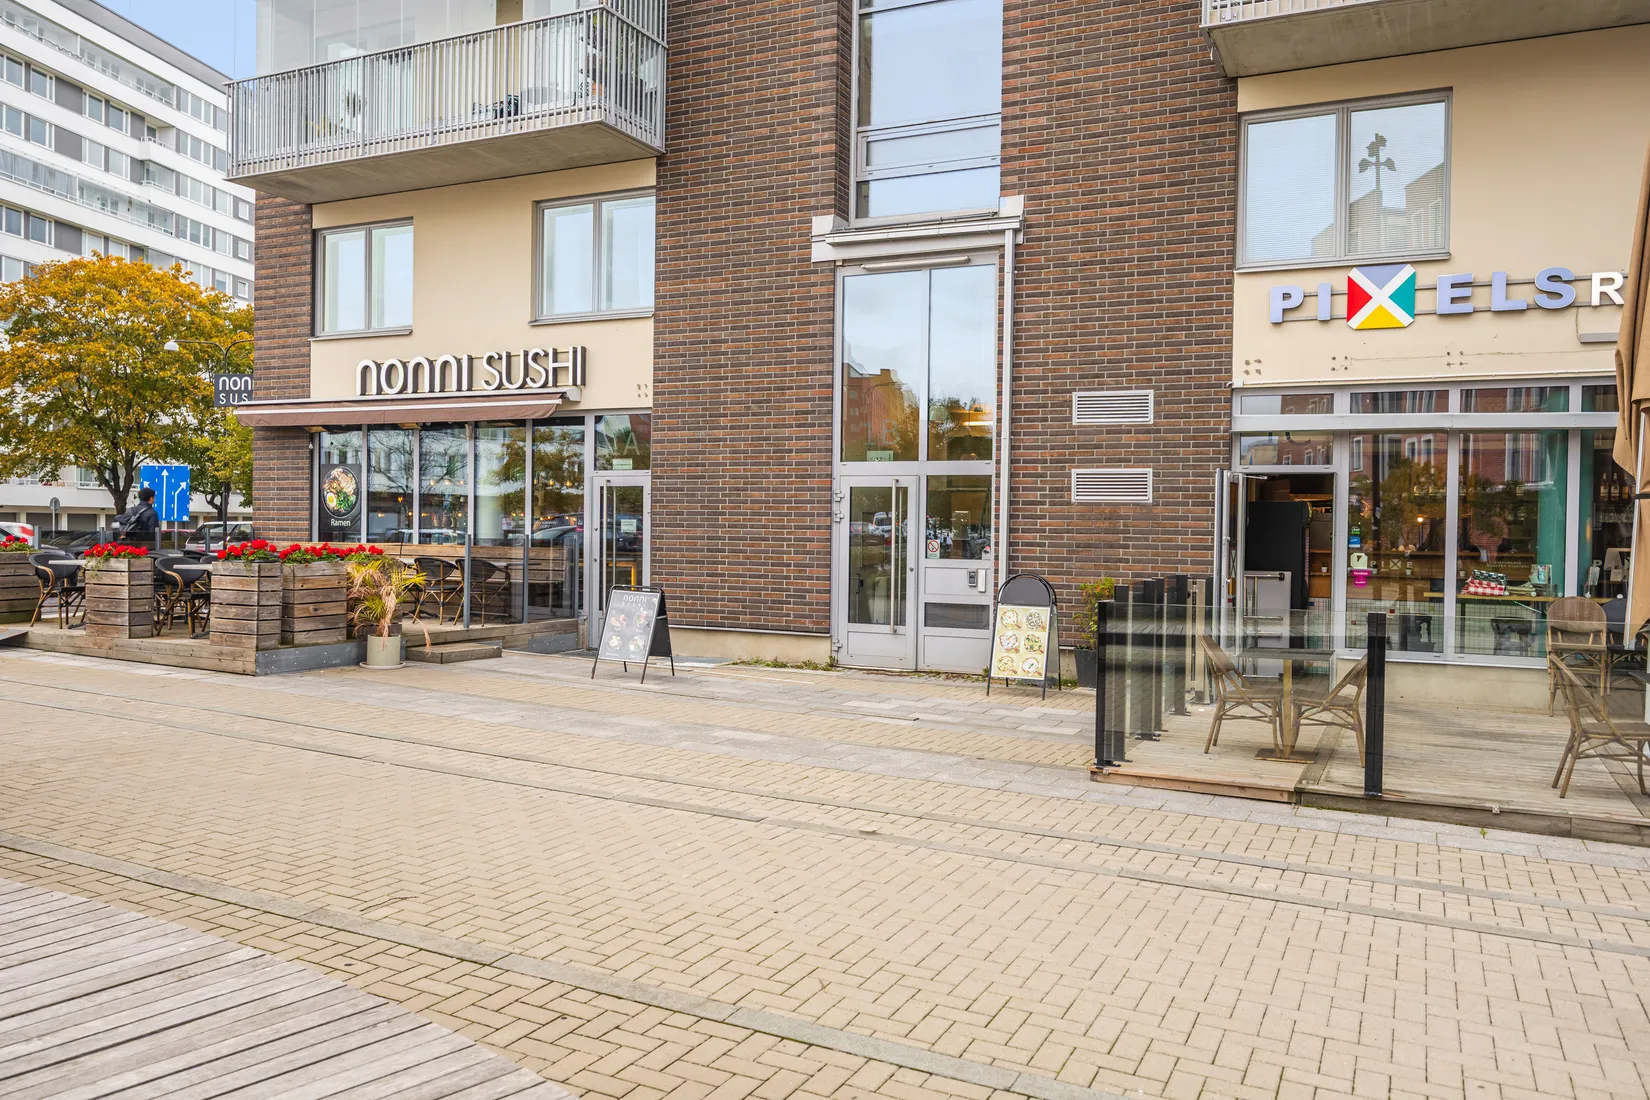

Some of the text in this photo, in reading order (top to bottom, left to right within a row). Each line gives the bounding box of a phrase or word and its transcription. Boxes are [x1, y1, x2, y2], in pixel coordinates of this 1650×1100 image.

[1269, 263, 1577, 330] PIXELS
[481, 346, 585, 391] SUSHI
[330, 518, 351, 527] Ramen
